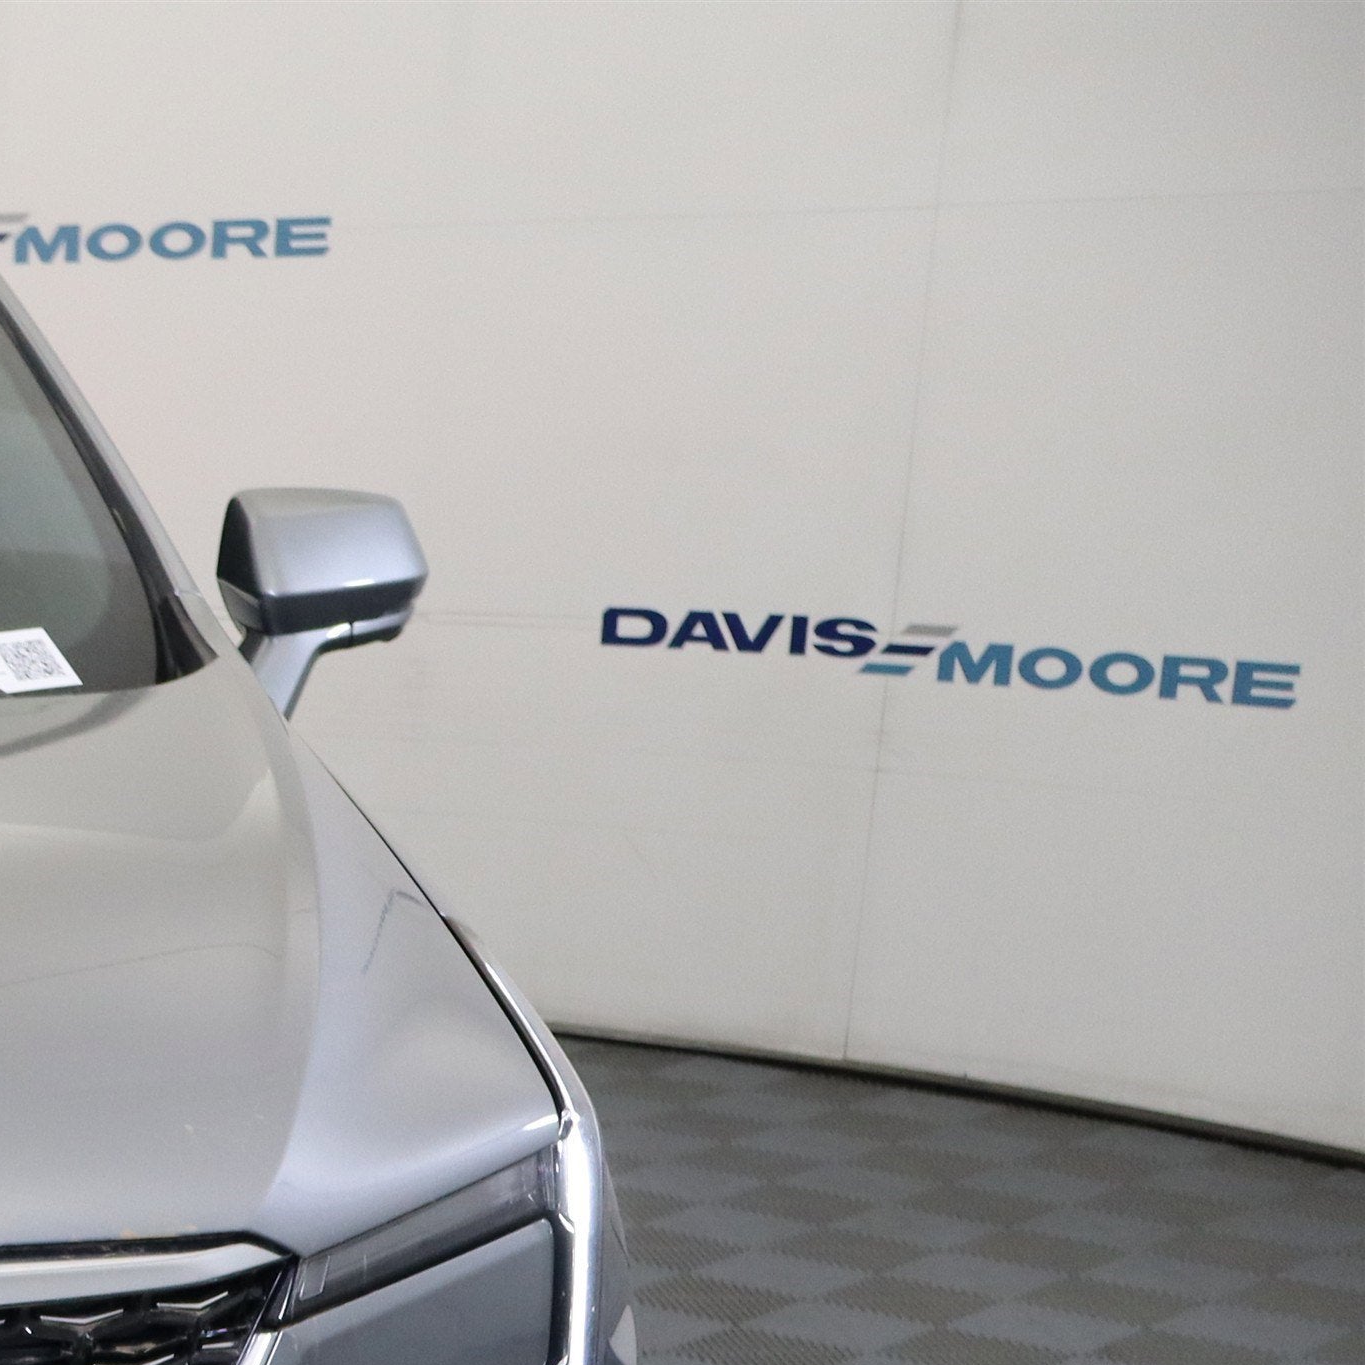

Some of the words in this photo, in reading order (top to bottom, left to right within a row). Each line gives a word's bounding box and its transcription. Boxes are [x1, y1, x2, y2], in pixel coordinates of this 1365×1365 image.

[13, 215, 333, 265] MOORE
[600, 606, 879, 658] DAVIS
[935, 640, 1302, 710] MOORE
